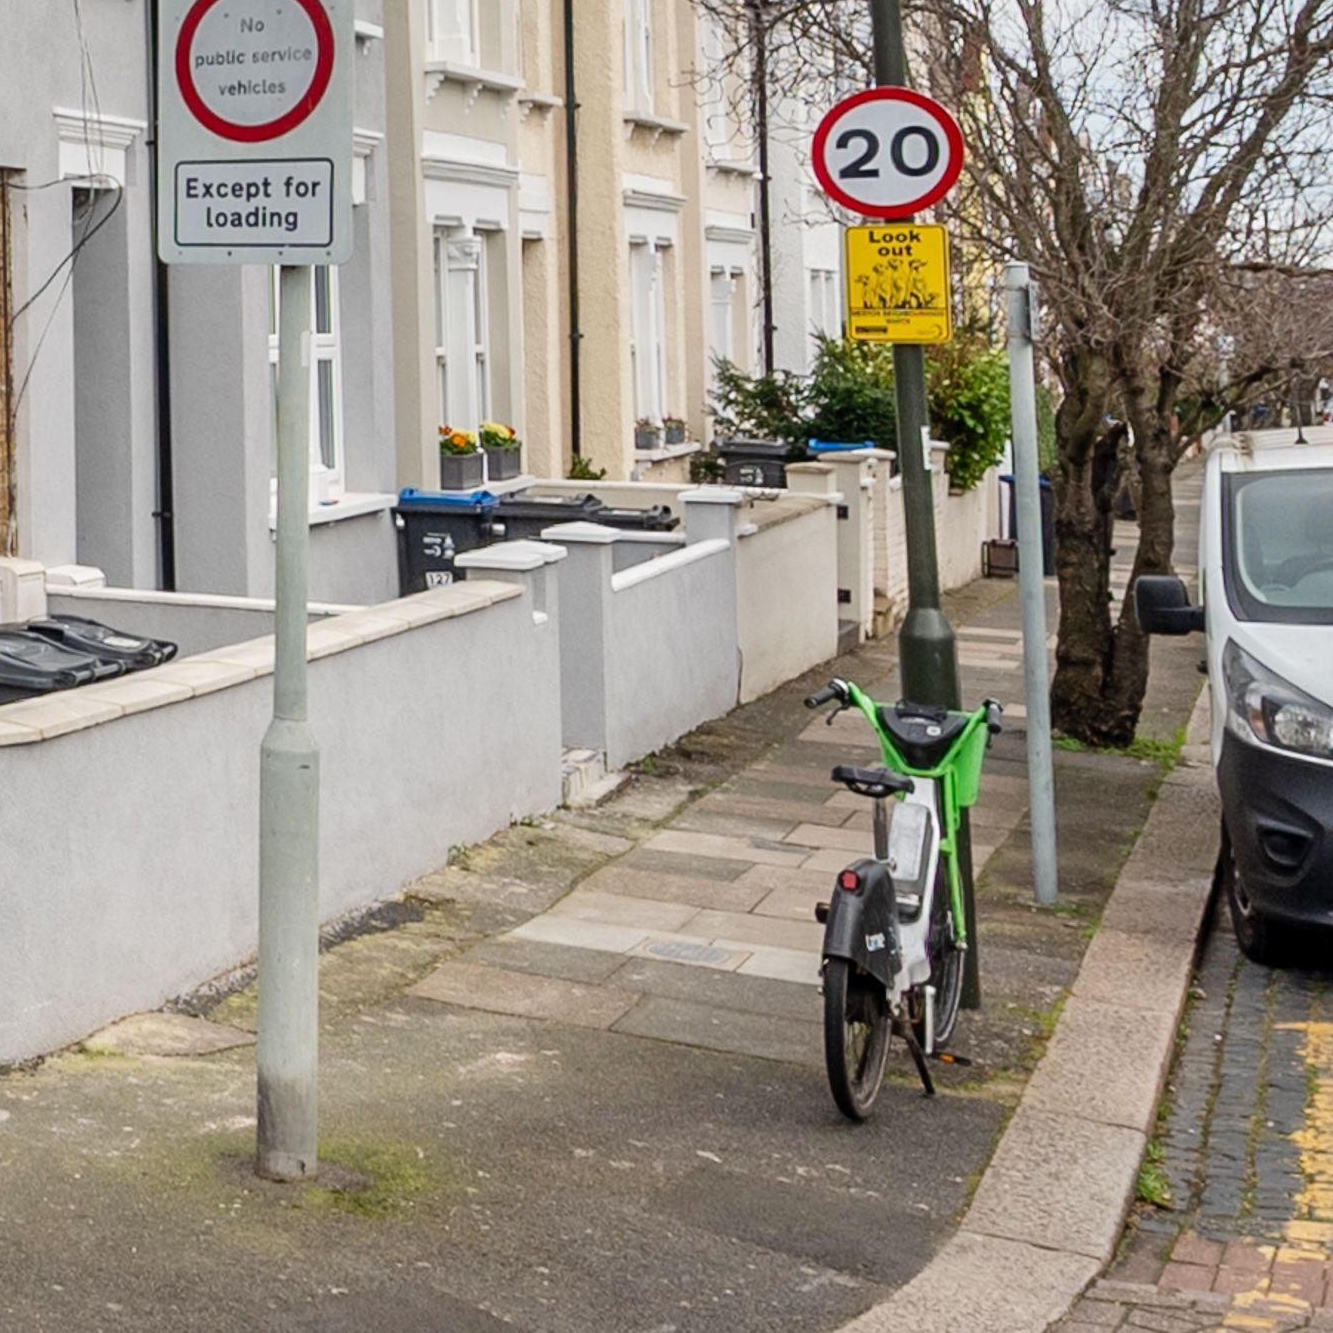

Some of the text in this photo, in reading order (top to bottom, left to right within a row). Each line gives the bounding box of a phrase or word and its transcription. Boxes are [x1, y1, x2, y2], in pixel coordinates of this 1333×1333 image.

[240, 16, 265, 33] No
[195, 46, 312, 69] public service
[218, 79, 286, 96] vehicles
[835, 125, 940, 179] 20
[186, 176, 321, 202] Except for
[206, 206, 298, 232] loading
[869, 230, 921, 244] Look
[877, 245, 913, 257] out
